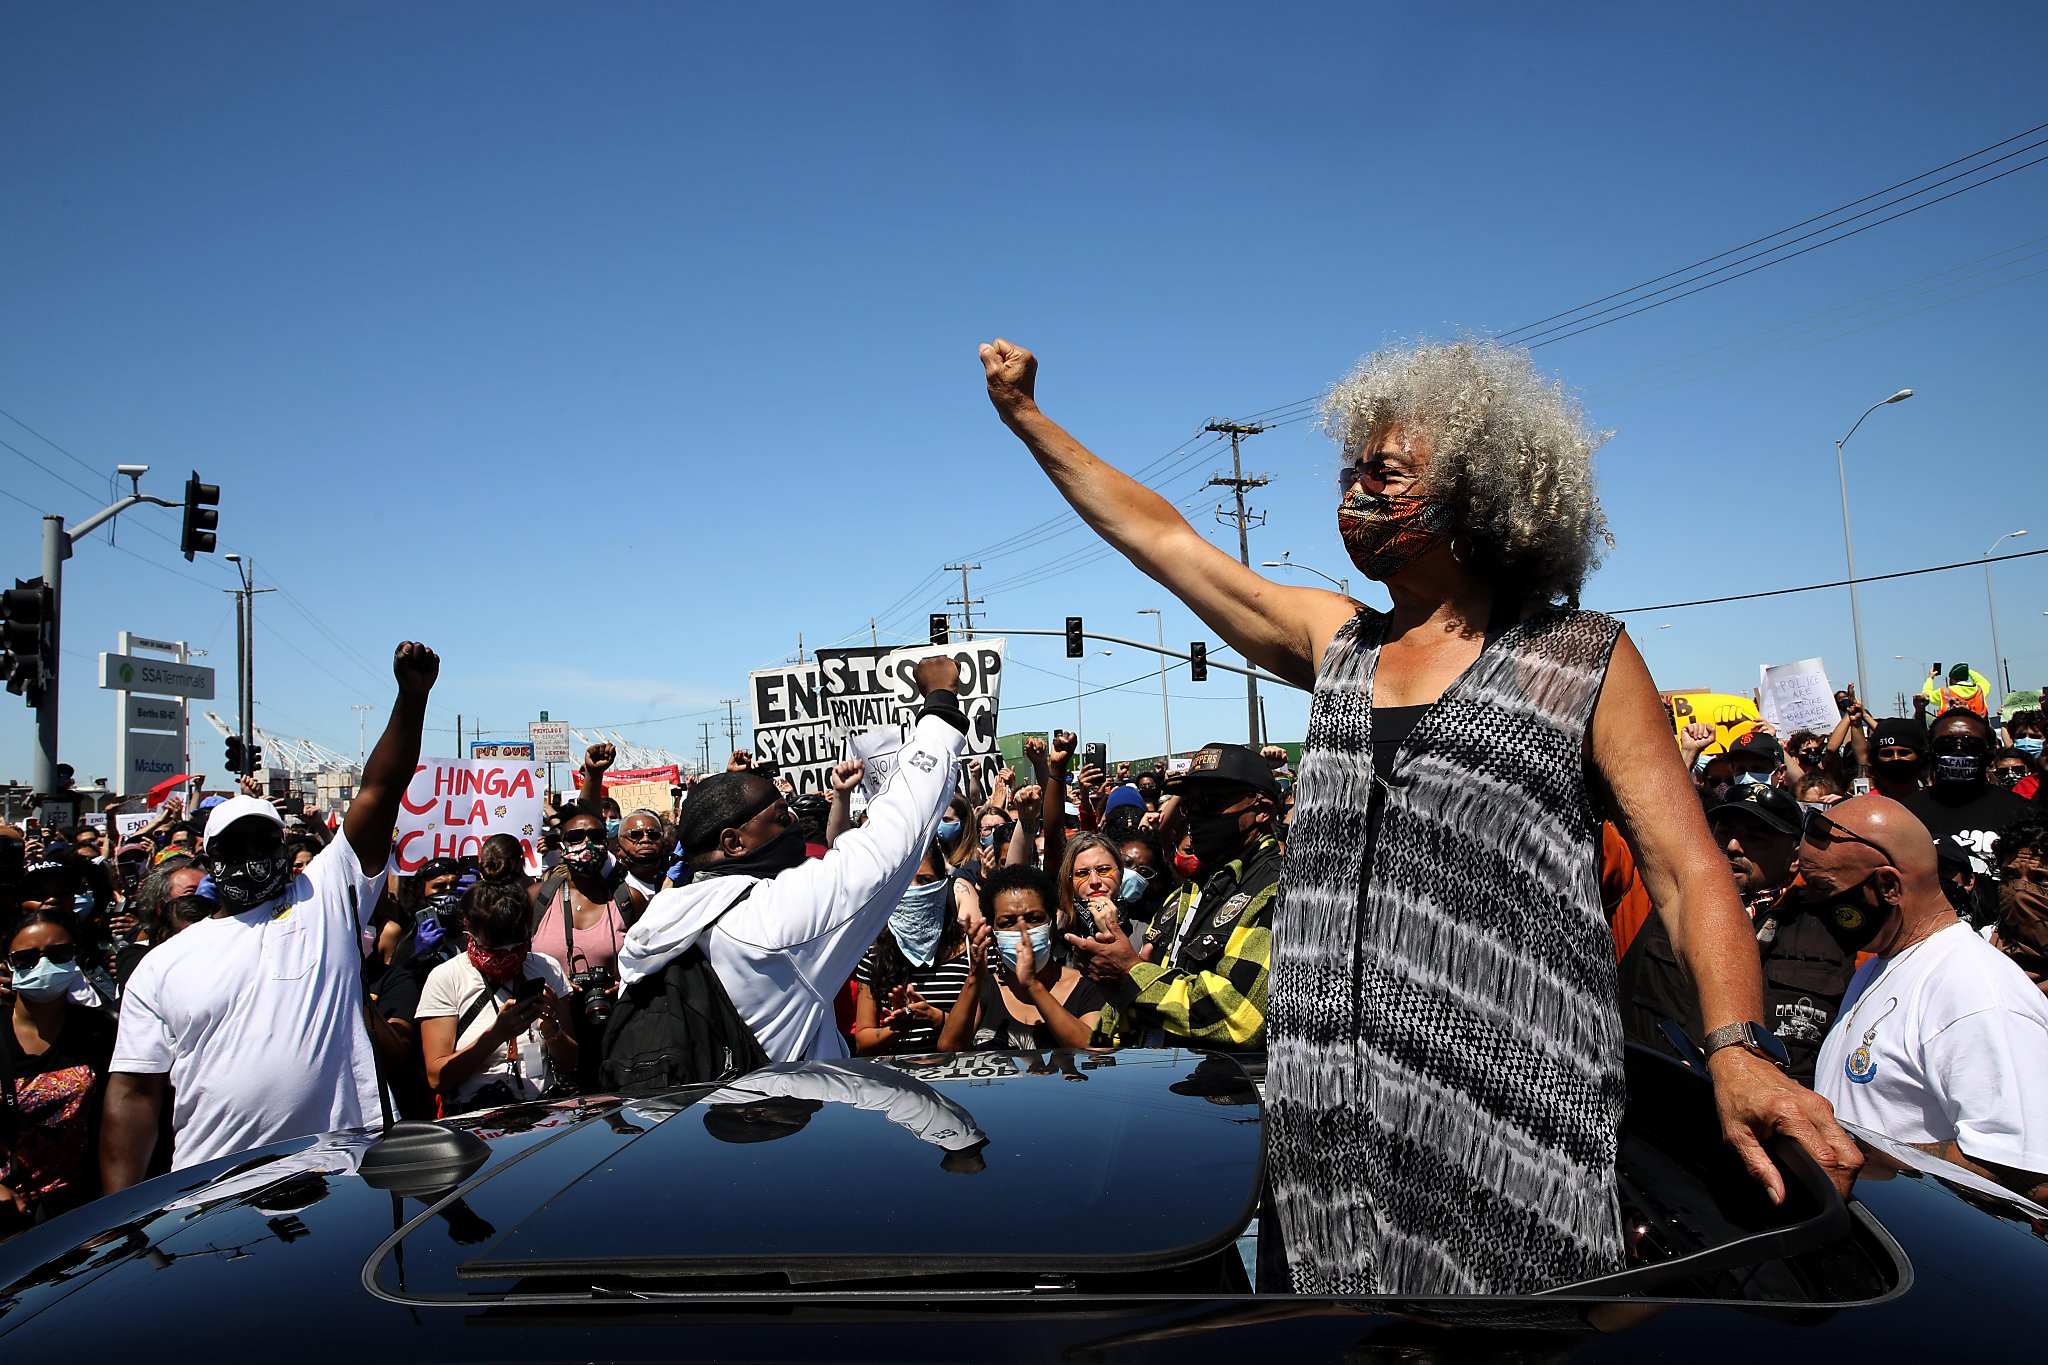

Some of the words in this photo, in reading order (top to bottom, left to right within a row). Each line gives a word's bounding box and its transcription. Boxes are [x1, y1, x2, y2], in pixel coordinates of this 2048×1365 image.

[823, 655, 894, 694] STO
[896, 649, 1001, 703] SOP
[755, 670, 829, 724] EN
[1879, 736, 1895, 746] 510
[476, 746, 497, 758] PUT
[135, 758, 174, 773] Matson
[400, 765, 535, 815] CHINGA
[614, 784, 656, 798] JUSTICE
[660, 783, 668, 795] 4
[621, 796, 656, 809] BLACK
[445, 800, 488, 826] LA
[127, 819, 149, 831] END
[395, 831, 537, 872] CHOA
